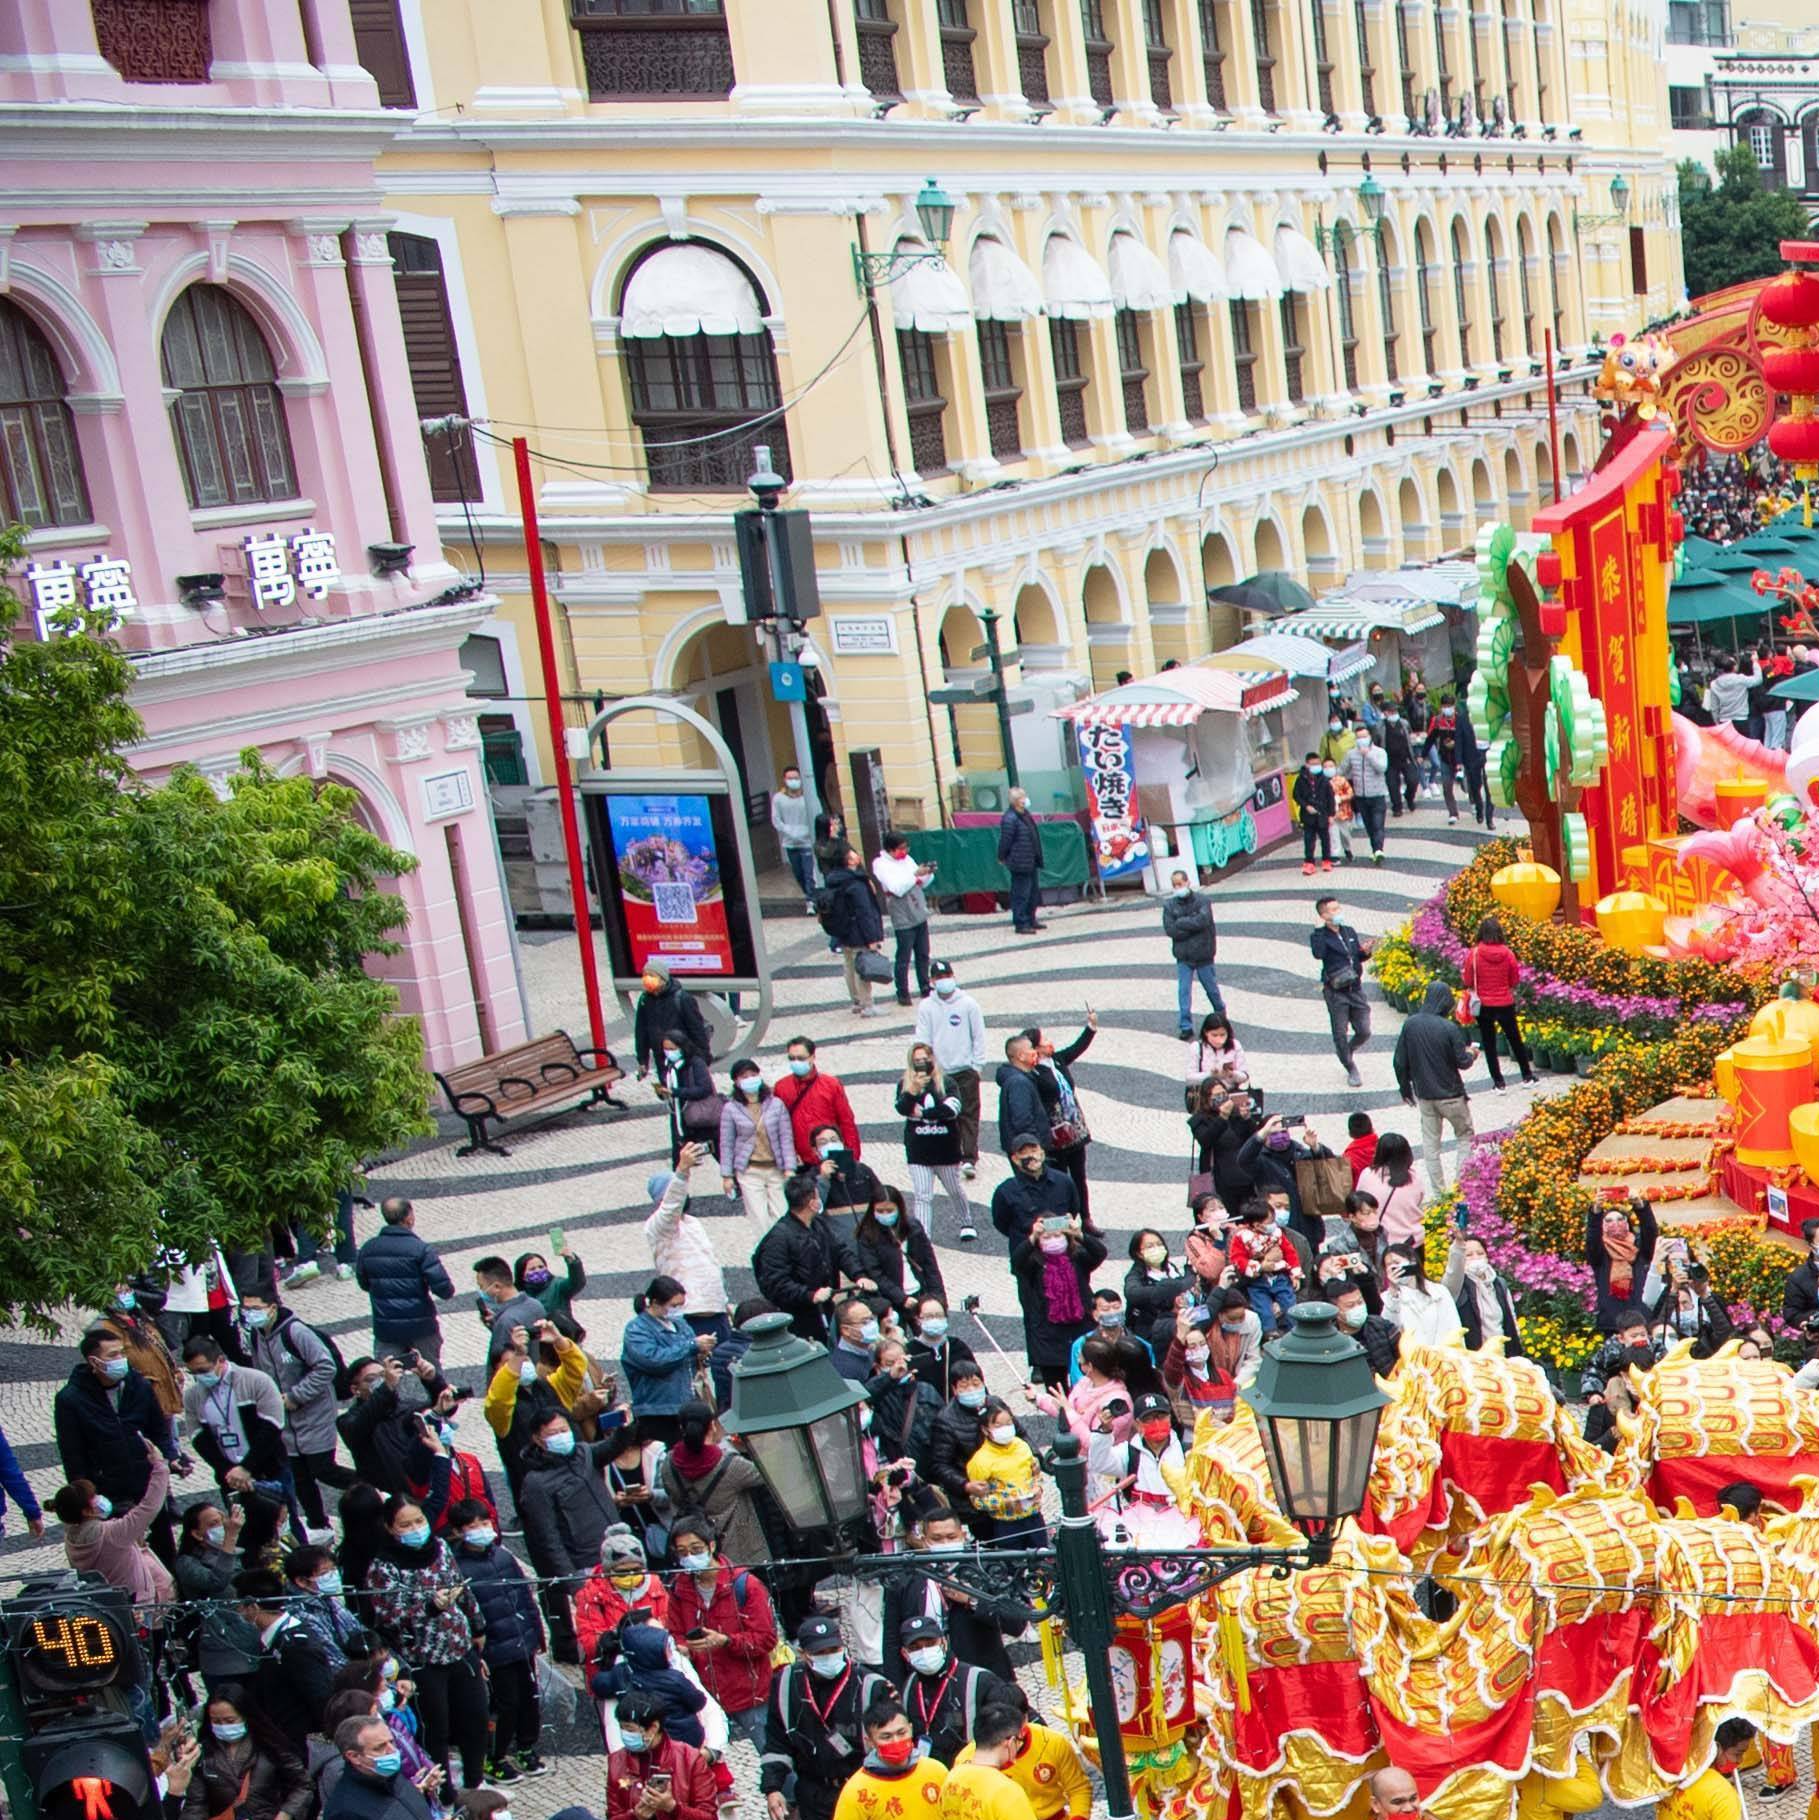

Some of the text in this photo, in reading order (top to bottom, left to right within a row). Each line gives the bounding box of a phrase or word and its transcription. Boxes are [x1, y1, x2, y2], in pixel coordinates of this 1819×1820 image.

[26, 552, 137, 642] 萬寧
[239, 527, 341, 610] 萬寧
[1602, 554, 1639, 838] 恭賀新禧
[1089, 725, 1127, 819] たい焼き
[915, 1125, 949, 1135] adidas
[34, 1616, 114, 1667] 40
